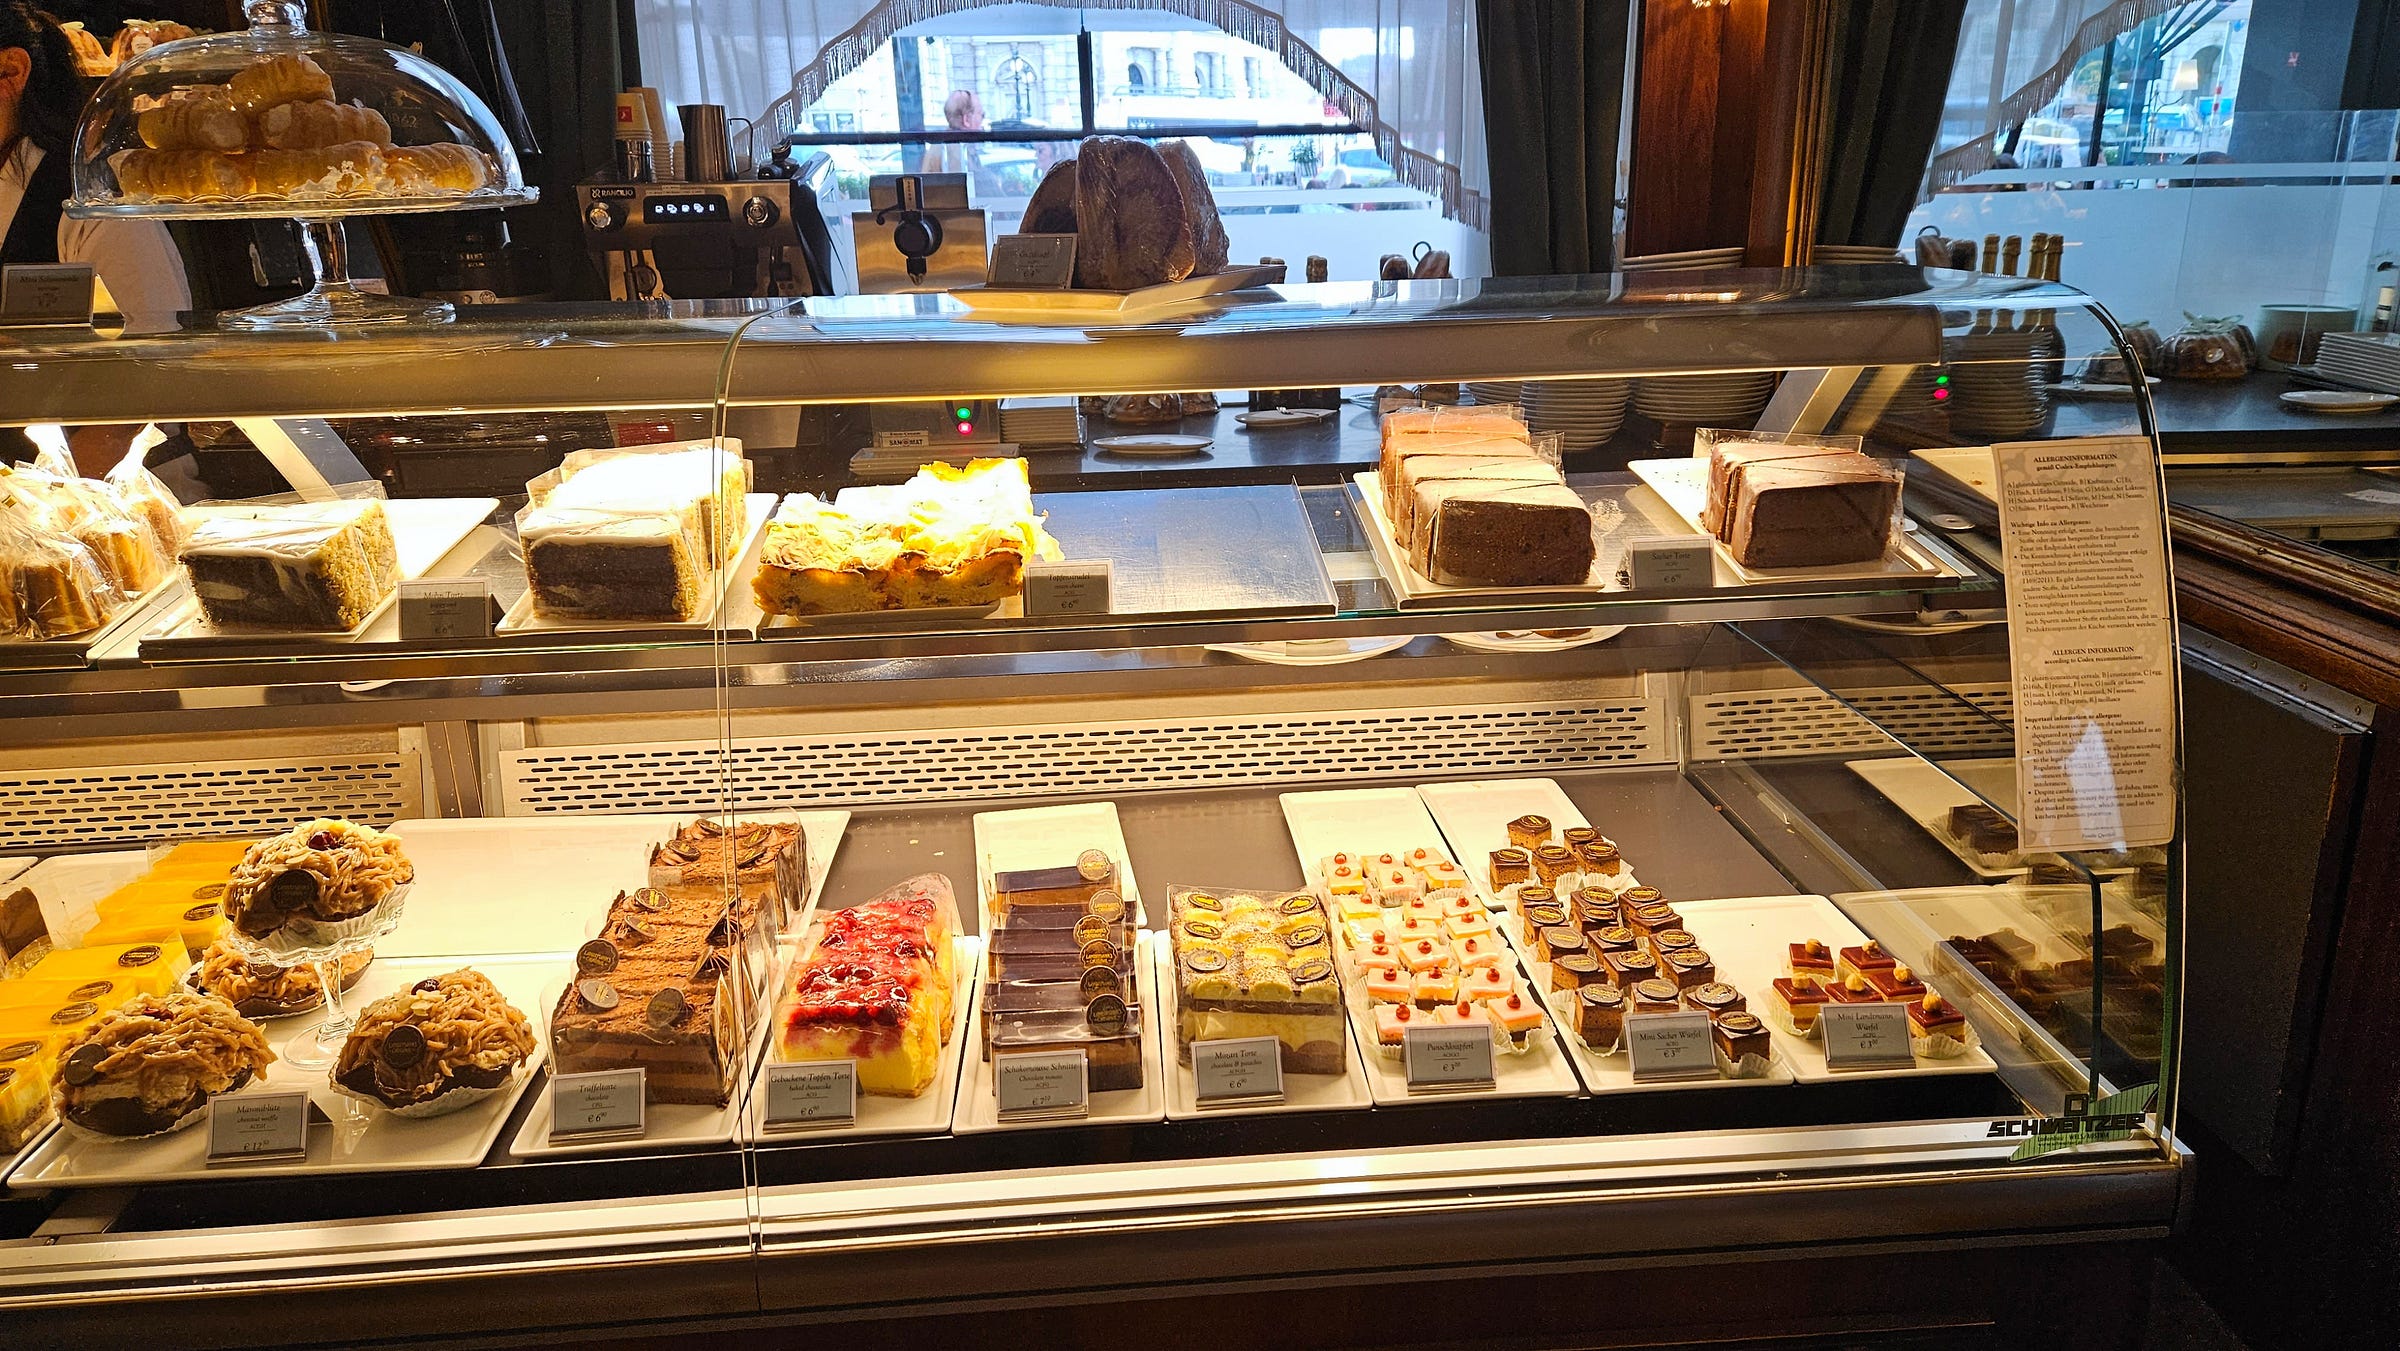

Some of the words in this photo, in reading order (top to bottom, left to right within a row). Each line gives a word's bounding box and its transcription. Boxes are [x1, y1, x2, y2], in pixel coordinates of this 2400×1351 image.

[601, 189, 634, 197] RANCILIO
[2033, 453, 2117, 462] ALLERGENINFORMATION
[1675, 551, 1690, 559] Torte
[446, 591, 464, 599] Torte
[2052, 647, 2086, 655] ALLERGEN
[2087, 645, 2134, 654] INFORMATION
[2095, 653, 2143, 662] recommendations:
[2024, 715, 2052, 723] Important
[2053, 713, 2087, 721] information
[1838, 1013, 1854, 1021] Mini
[1214, 1052, 1238, 1060] Mozart
[771, 1074, 806, 1083] Gebackene
[808, 1073, 831, 1082] Topfen
[833, 1072, 850, 1080] Torte
[1986, 1112, 2145, 1138] SCHWEITZER
